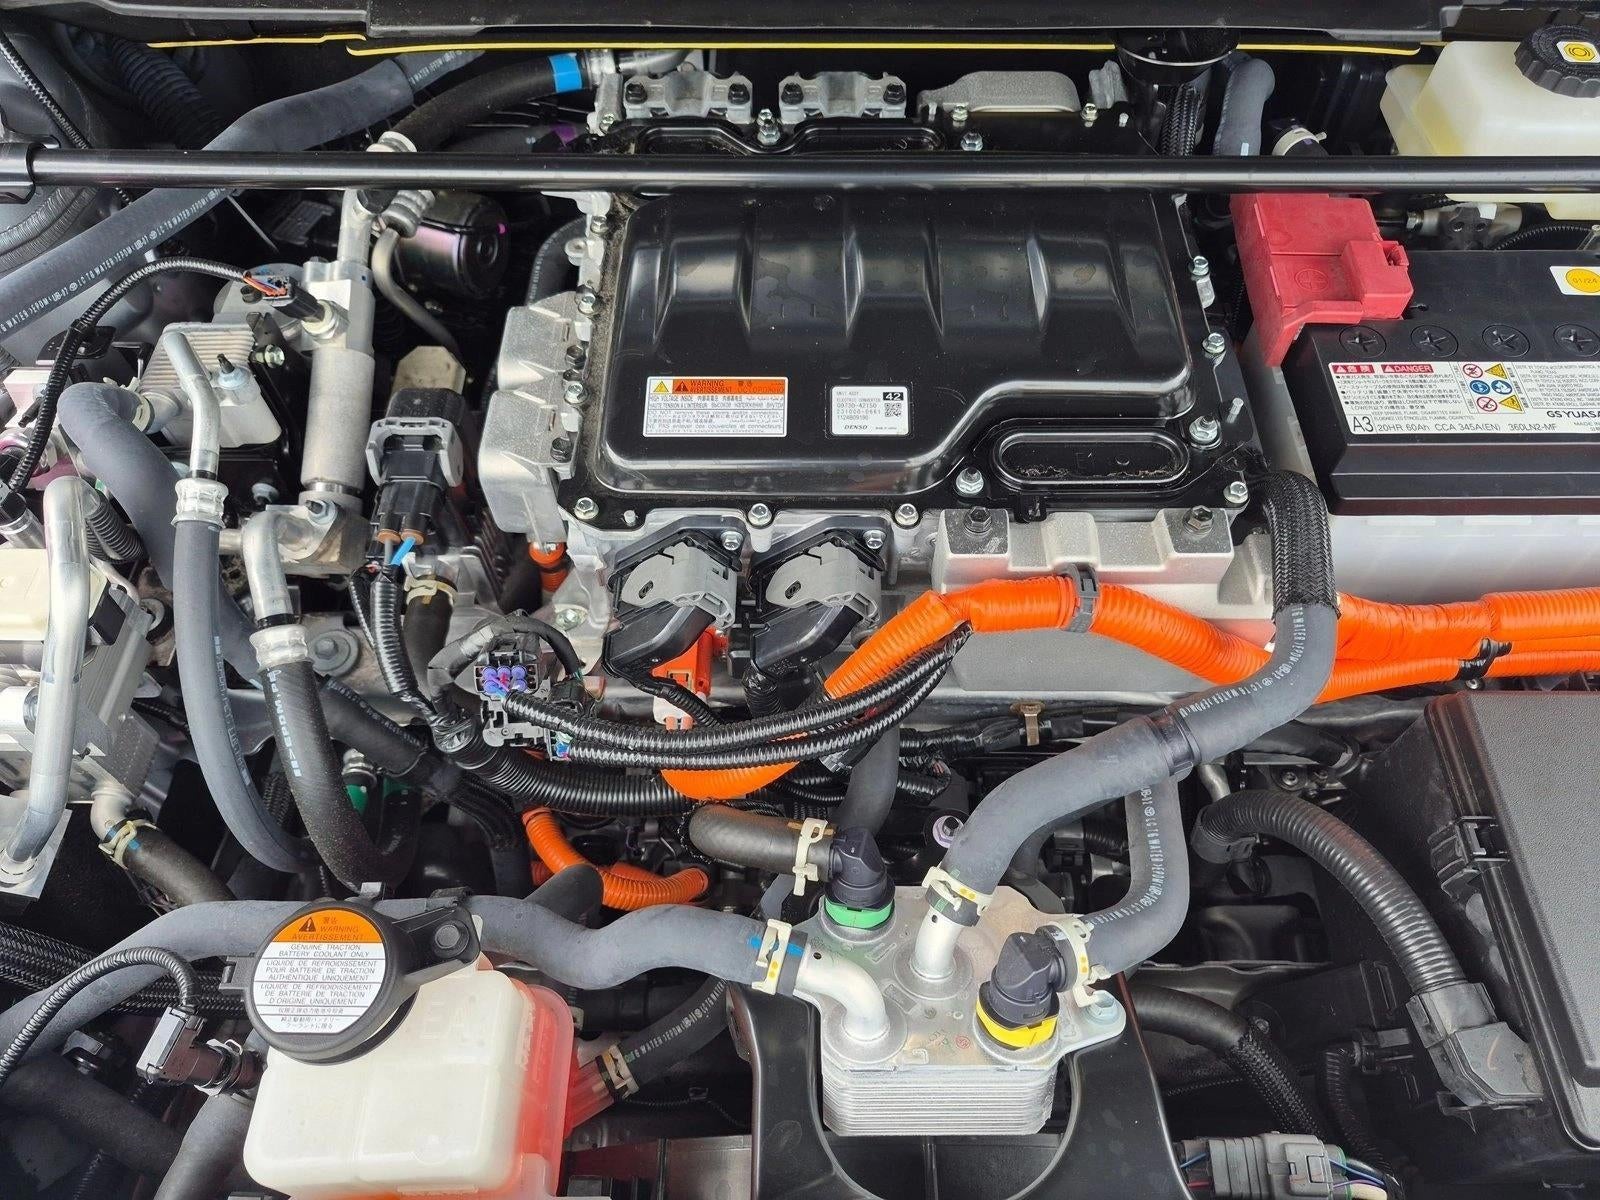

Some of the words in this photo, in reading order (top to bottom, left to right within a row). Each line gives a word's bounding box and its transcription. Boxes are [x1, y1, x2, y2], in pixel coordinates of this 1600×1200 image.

[1394, 365, 1432, 373] DANGER
[885, 392, 901, 400] 42
[1353, 416, 1373, 432] A3
[1293, 617, 1306, 641] WATER
[1212, 689, 1239, 705] WATER
[1148, 838, 1164, 862] WATER
[291, 933, 363, 941] AVERTISSEMENT
[320, 925, 359, 933] WARNING
[640, 1037, 663, 1054] WATER
